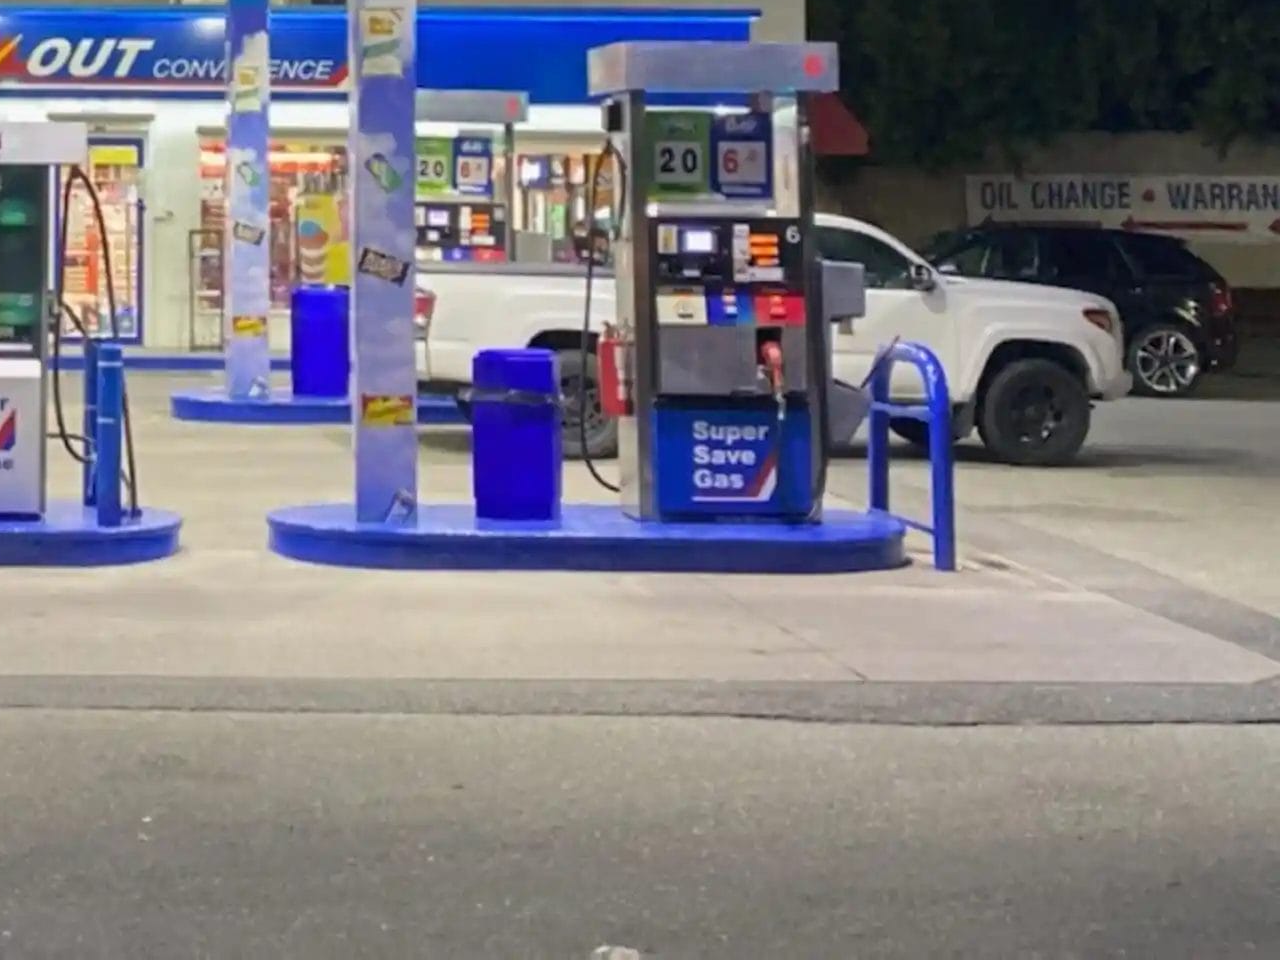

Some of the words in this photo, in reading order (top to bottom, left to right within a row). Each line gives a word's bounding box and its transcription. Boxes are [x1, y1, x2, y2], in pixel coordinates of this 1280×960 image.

[26, 38, 155, 77] OUT
[660, 147, 697, 174] 20
[980, 182, 1017, 209] OIL
[1031, 181, 1131, 209] CHANGE
[1167, 183, 1280, 211] WARRAN
[692, 421, 769, 444] Super
[693, 445, 756, 465] Save
[693, 470, 744, 489] Gas
